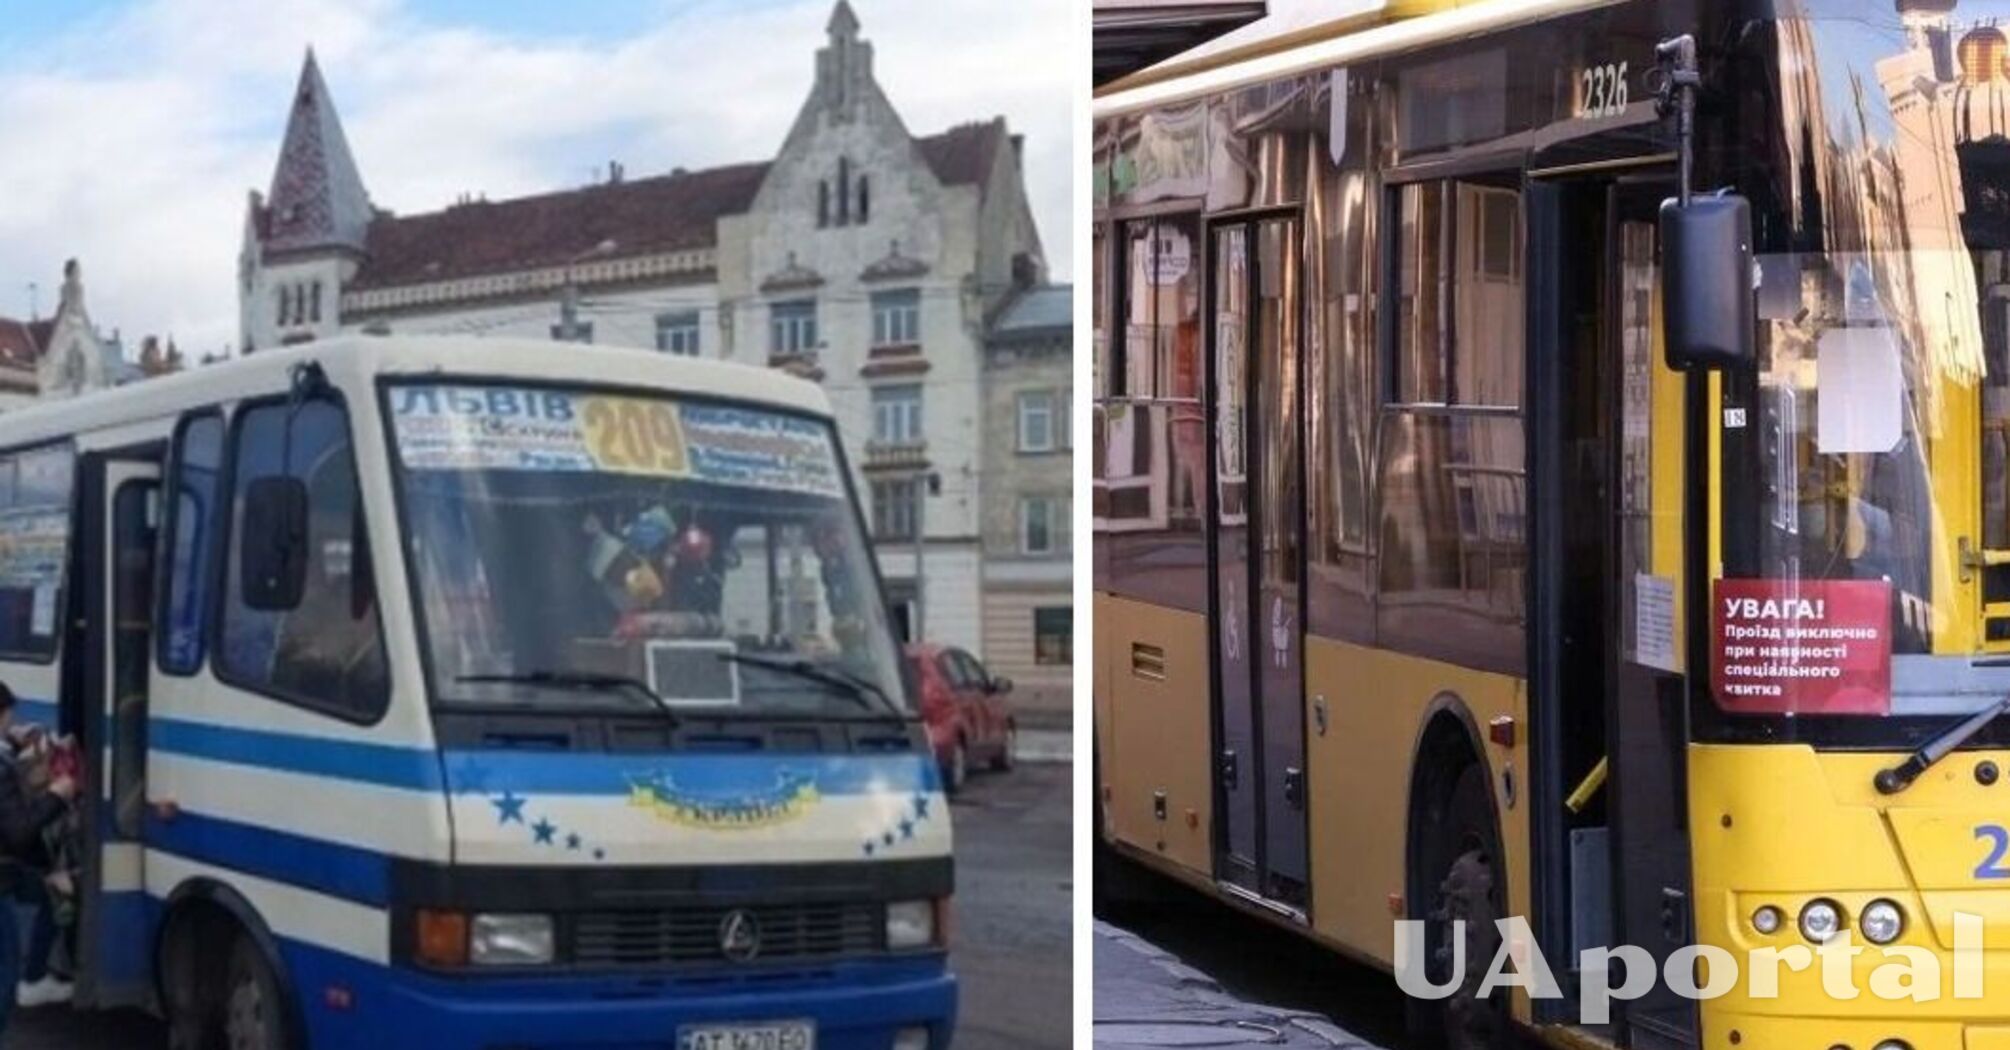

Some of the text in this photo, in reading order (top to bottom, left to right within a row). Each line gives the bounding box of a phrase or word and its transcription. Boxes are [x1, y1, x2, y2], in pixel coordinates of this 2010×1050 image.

[1581, 61, 1628, 118] 2326
[397, 388, 575, 421] ЛЬВІВ
[584, 399, 687, 473] 209
[1725, 598, 1825, 620] УВАГА!
[1725, 624, 1879, 640] Проїзд виключно
[1725, 643, 1848, 660] при наявності
[1724, 662, 1840, 678] спеціального
[1974, 824, 2010, 878] 2
